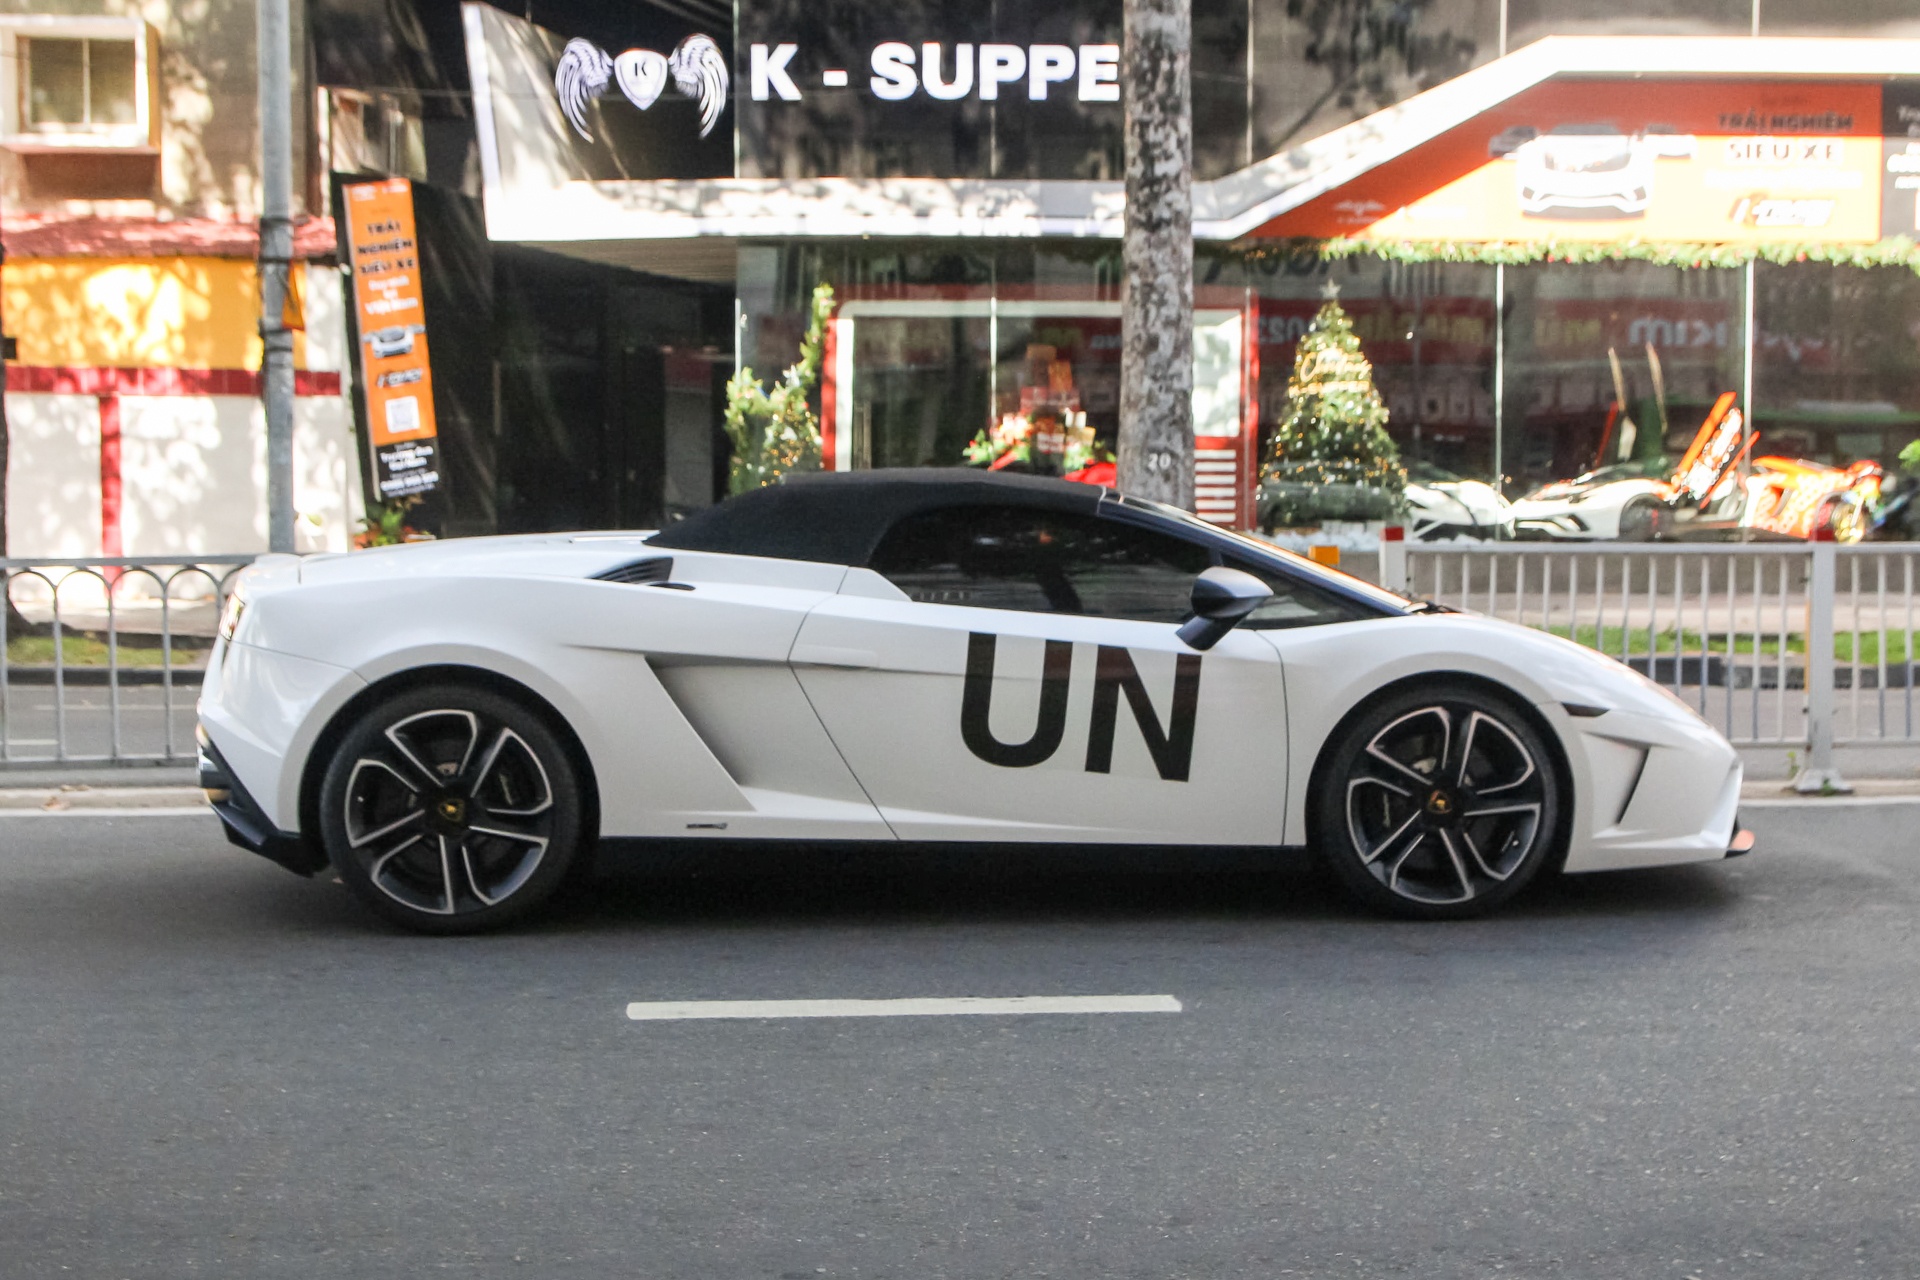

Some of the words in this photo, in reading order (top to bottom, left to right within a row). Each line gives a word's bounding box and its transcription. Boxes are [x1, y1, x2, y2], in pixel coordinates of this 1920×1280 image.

[634, 60, 648, 77] K
[750, 42, 802, 101] K
[870, 41, 1120, 101] SUPPE
[1148, 452, 1172, 471] 20
[960, 631, 1202, 782] UN
